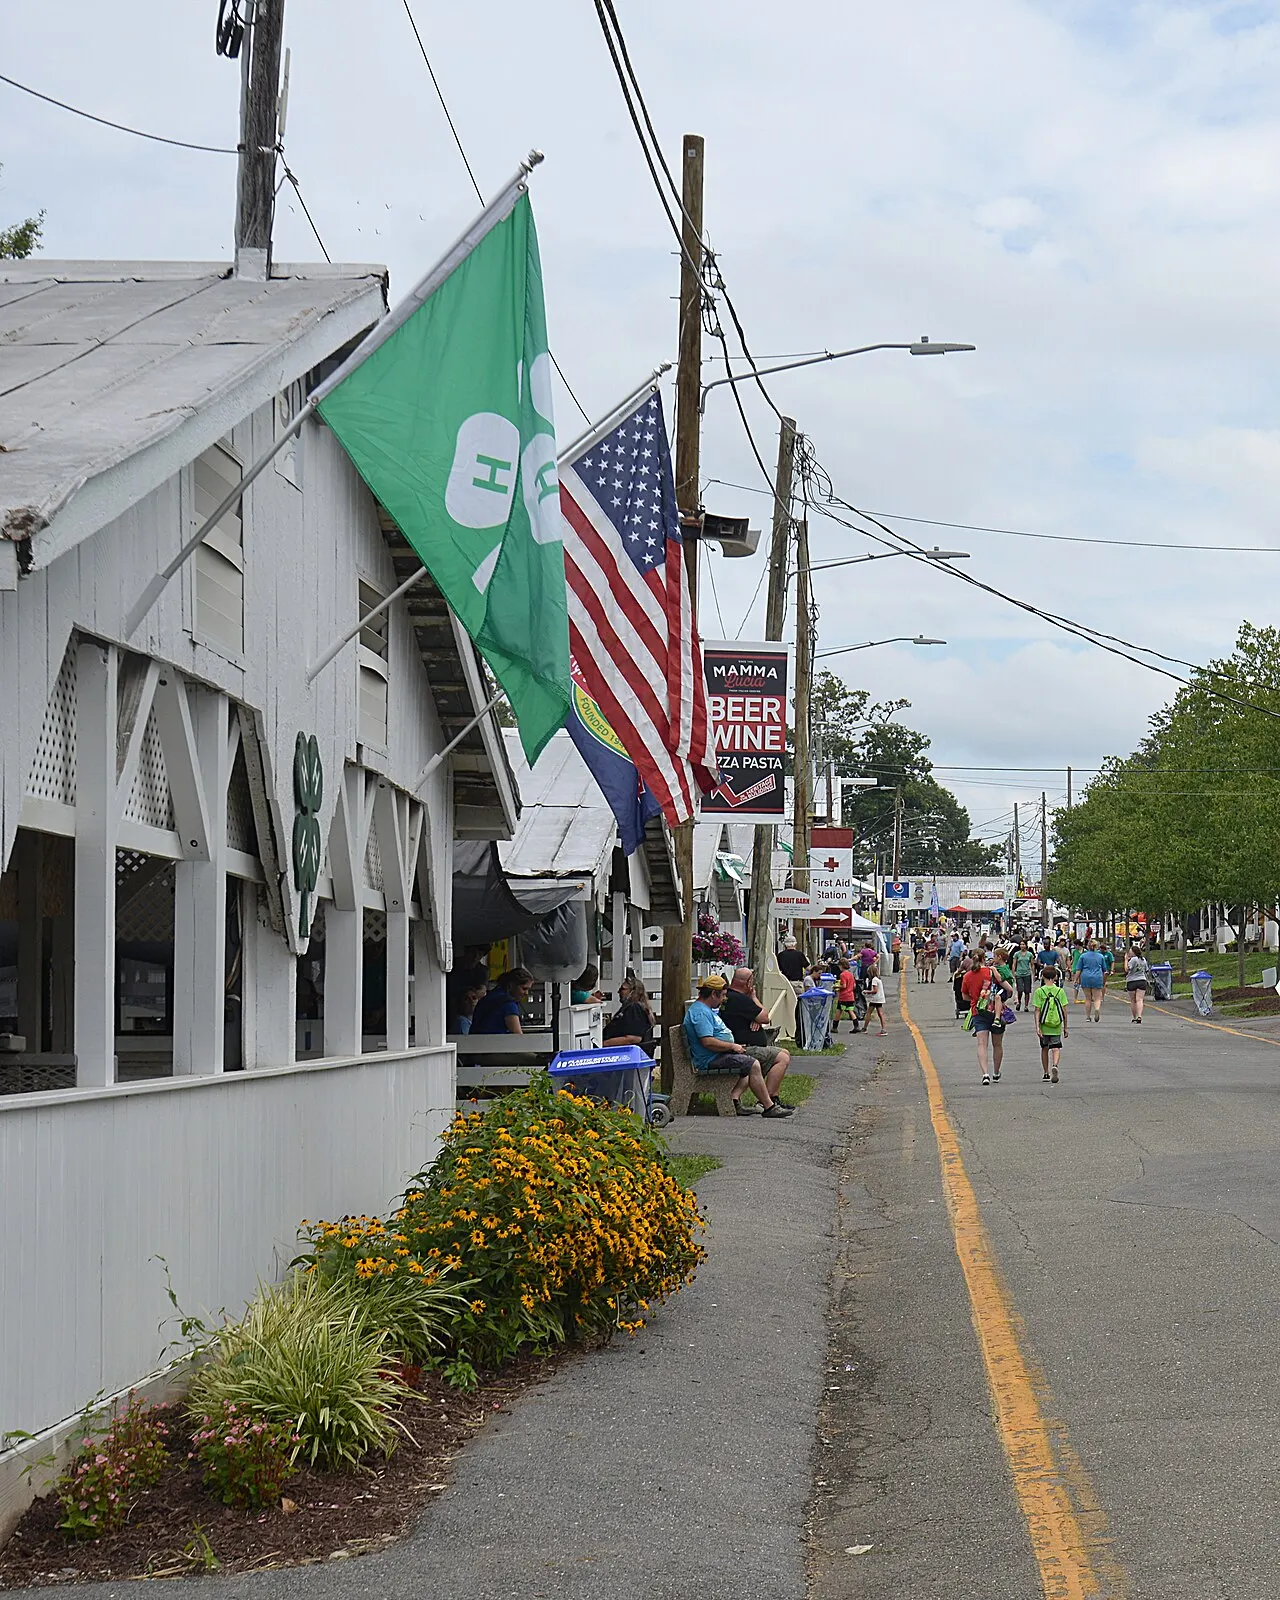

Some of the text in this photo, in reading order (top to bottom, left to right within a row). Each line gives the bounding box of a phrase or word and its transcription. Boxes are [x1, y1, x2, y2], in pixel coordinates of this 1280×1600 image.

[472, 453, 511, 495] H
[713, 665, 778, 679] MAMMA
[724, 673, 765, 688] Lucia
[709, 697, 781, 722] BEER
[580, 697, 625, 748] FOUNDED 194
[714, 725, 781, 750] WINE
[717, 756, 782, 769] ZZA PASTA
[812, 878, 850, 887] First Aid
[817, 890, 847, 899] Station
